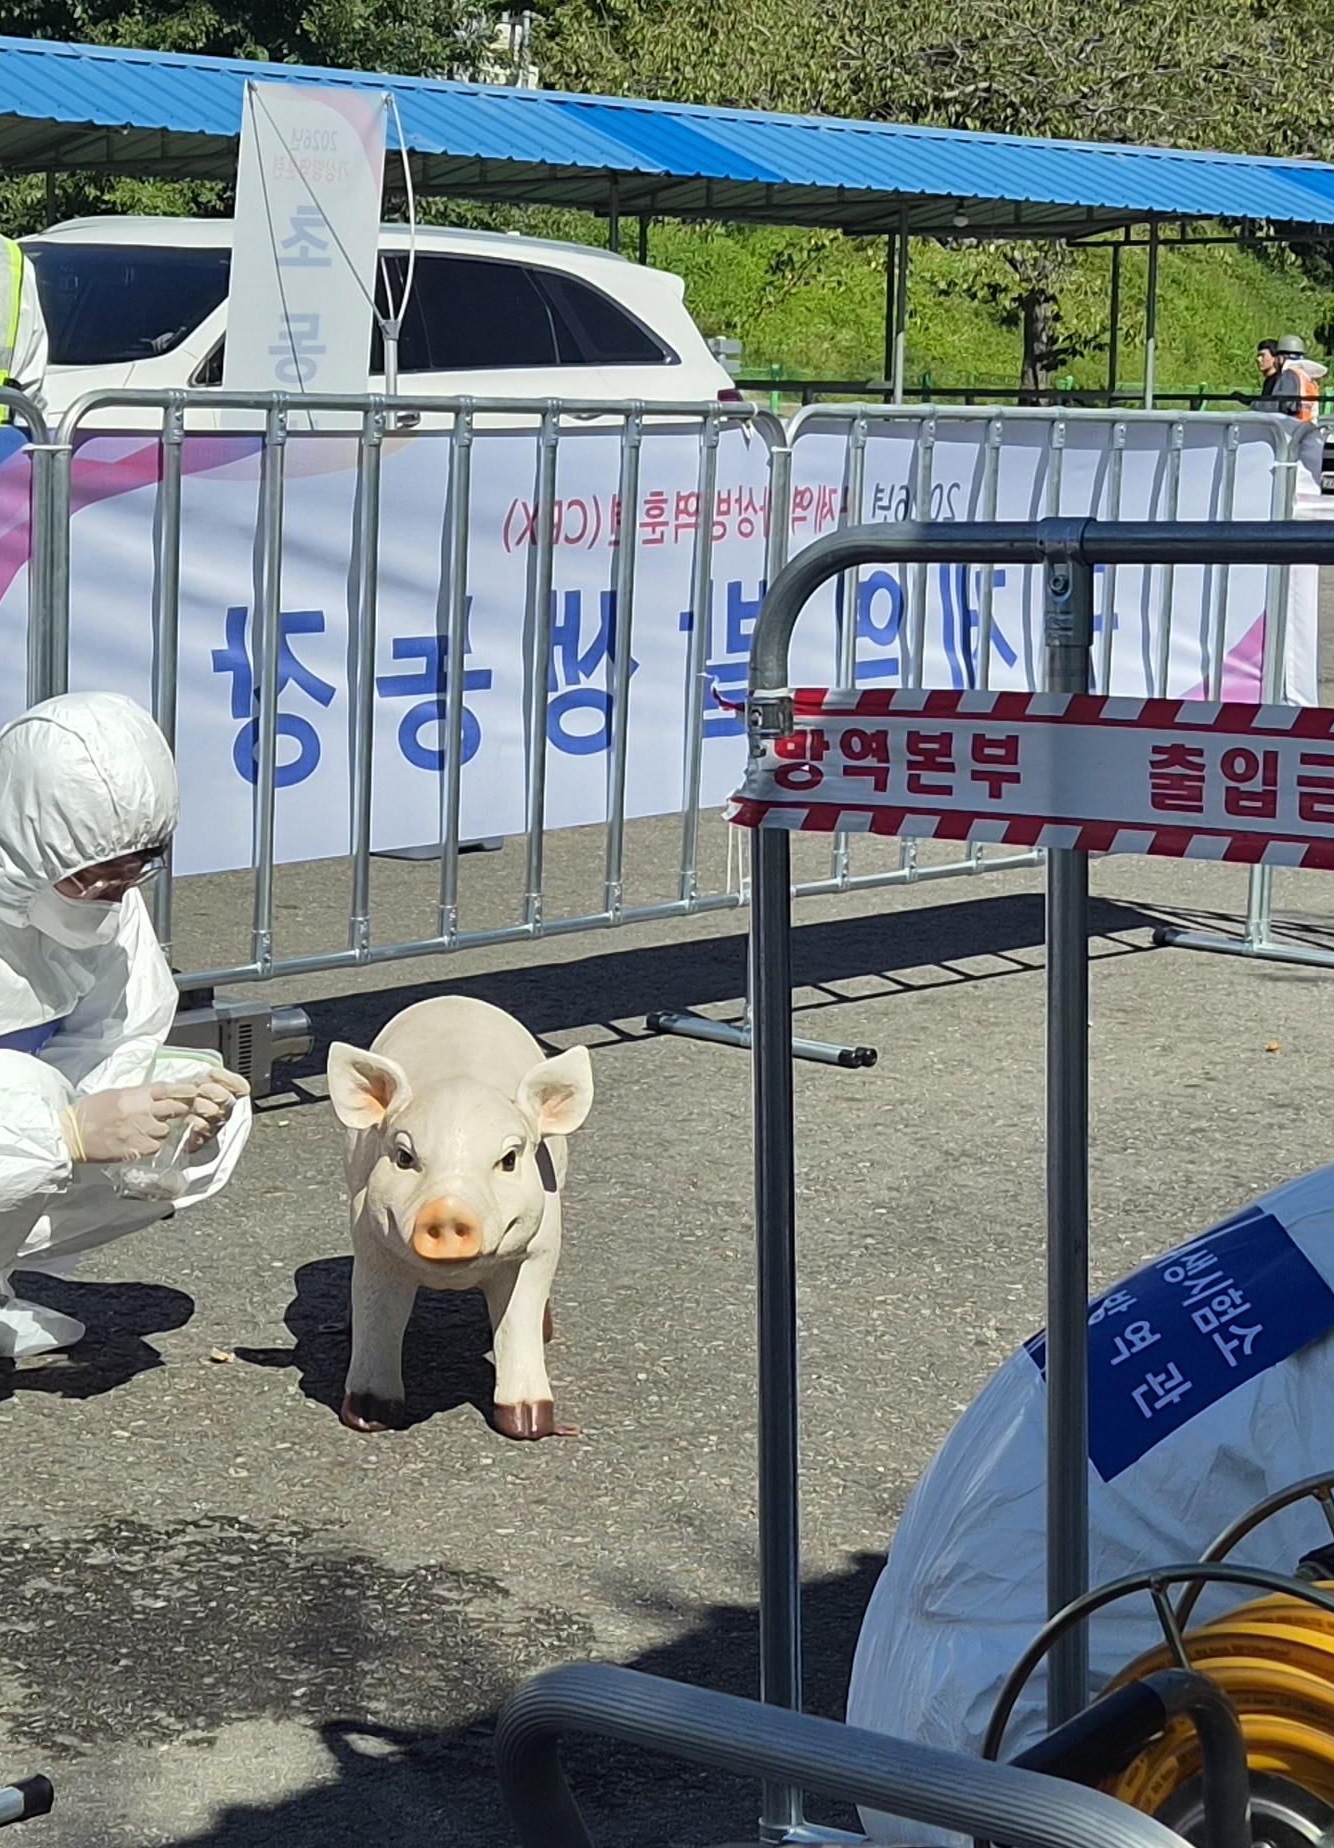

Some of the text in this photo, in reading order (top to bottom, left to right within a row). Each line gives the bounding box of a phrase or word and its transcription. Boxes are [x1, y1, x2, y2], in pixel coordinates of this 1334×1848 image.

[773, 726, 1021, 799] 방역본부
[1088, 1290, 1194, 1419] 방역관
[1156, 1248, 1264, 1368] 생시험소
